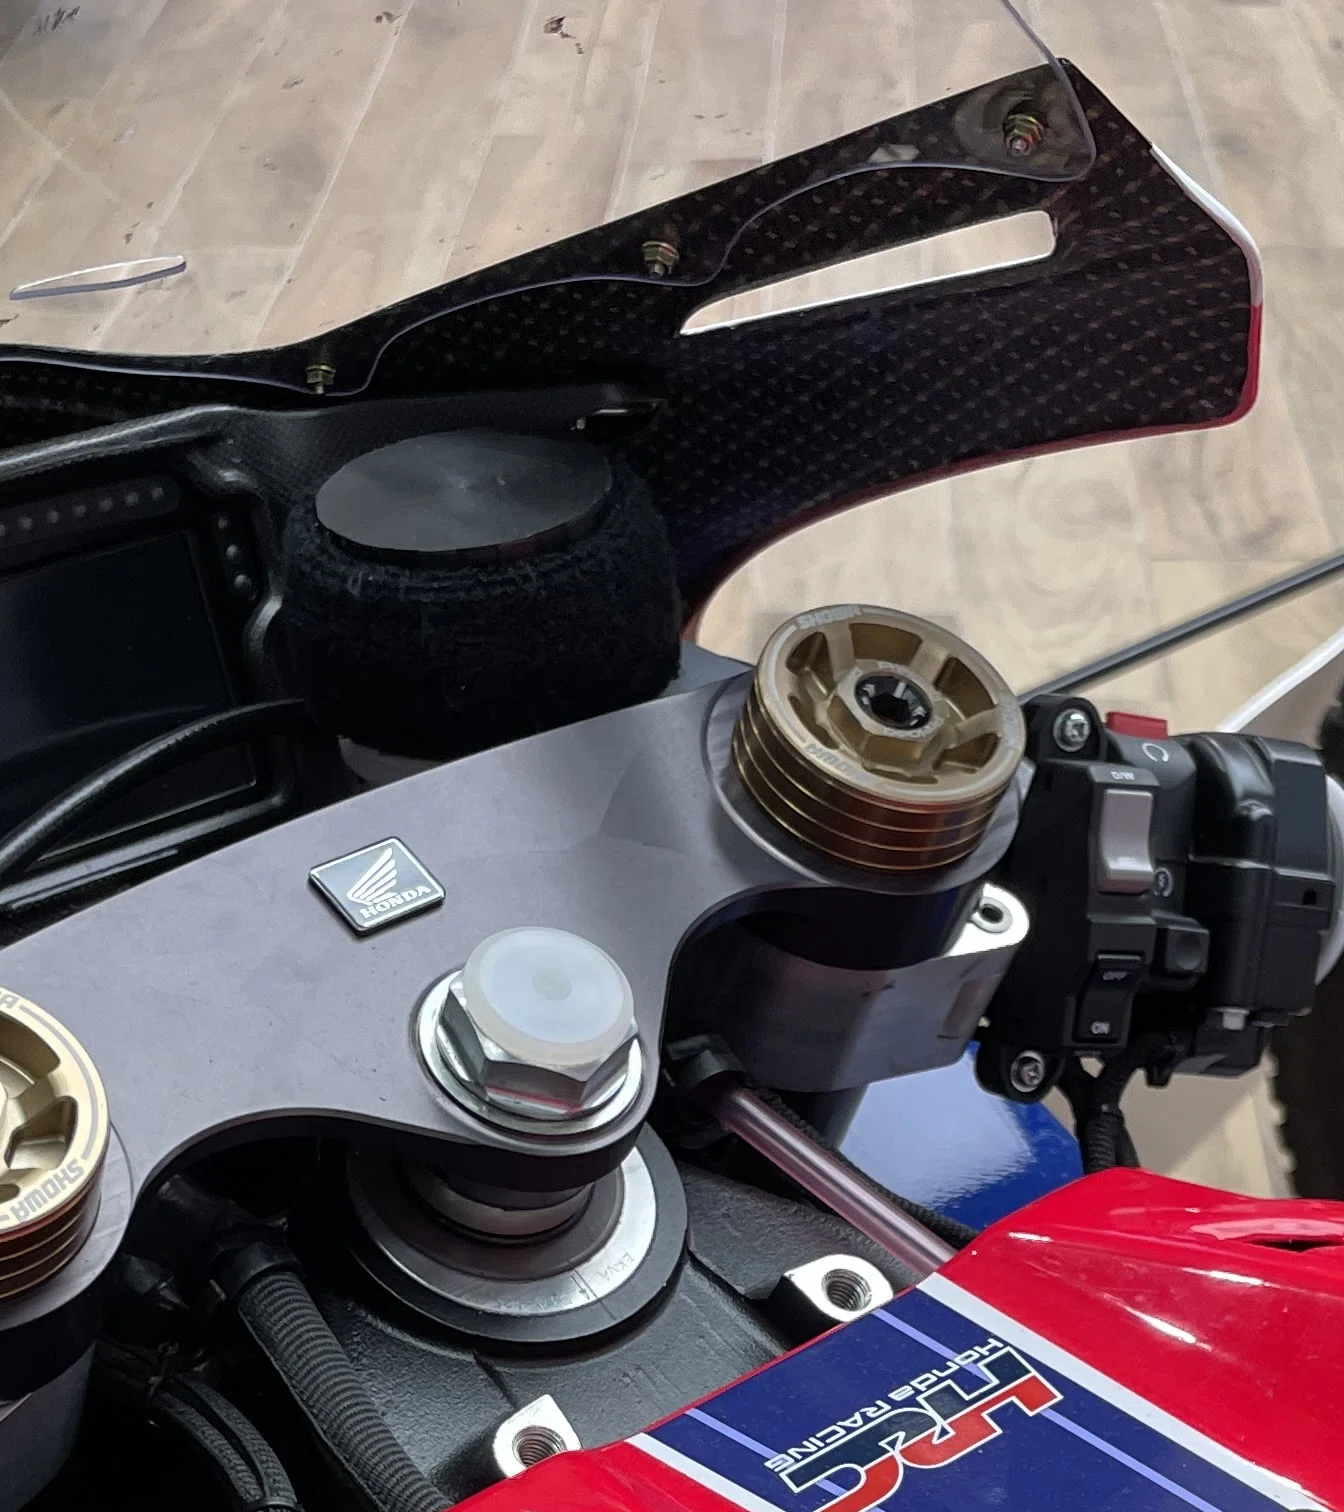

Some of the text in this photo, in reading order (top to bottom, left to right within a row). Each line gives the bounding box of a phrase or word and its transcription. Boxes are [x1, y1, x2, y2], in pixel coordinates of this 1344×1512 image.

[359, 884, 432, 919] HONDA
[10, 1156, 86, 1223] SHOWA
[764, 1338, 1004, 1472] Honda RACING
